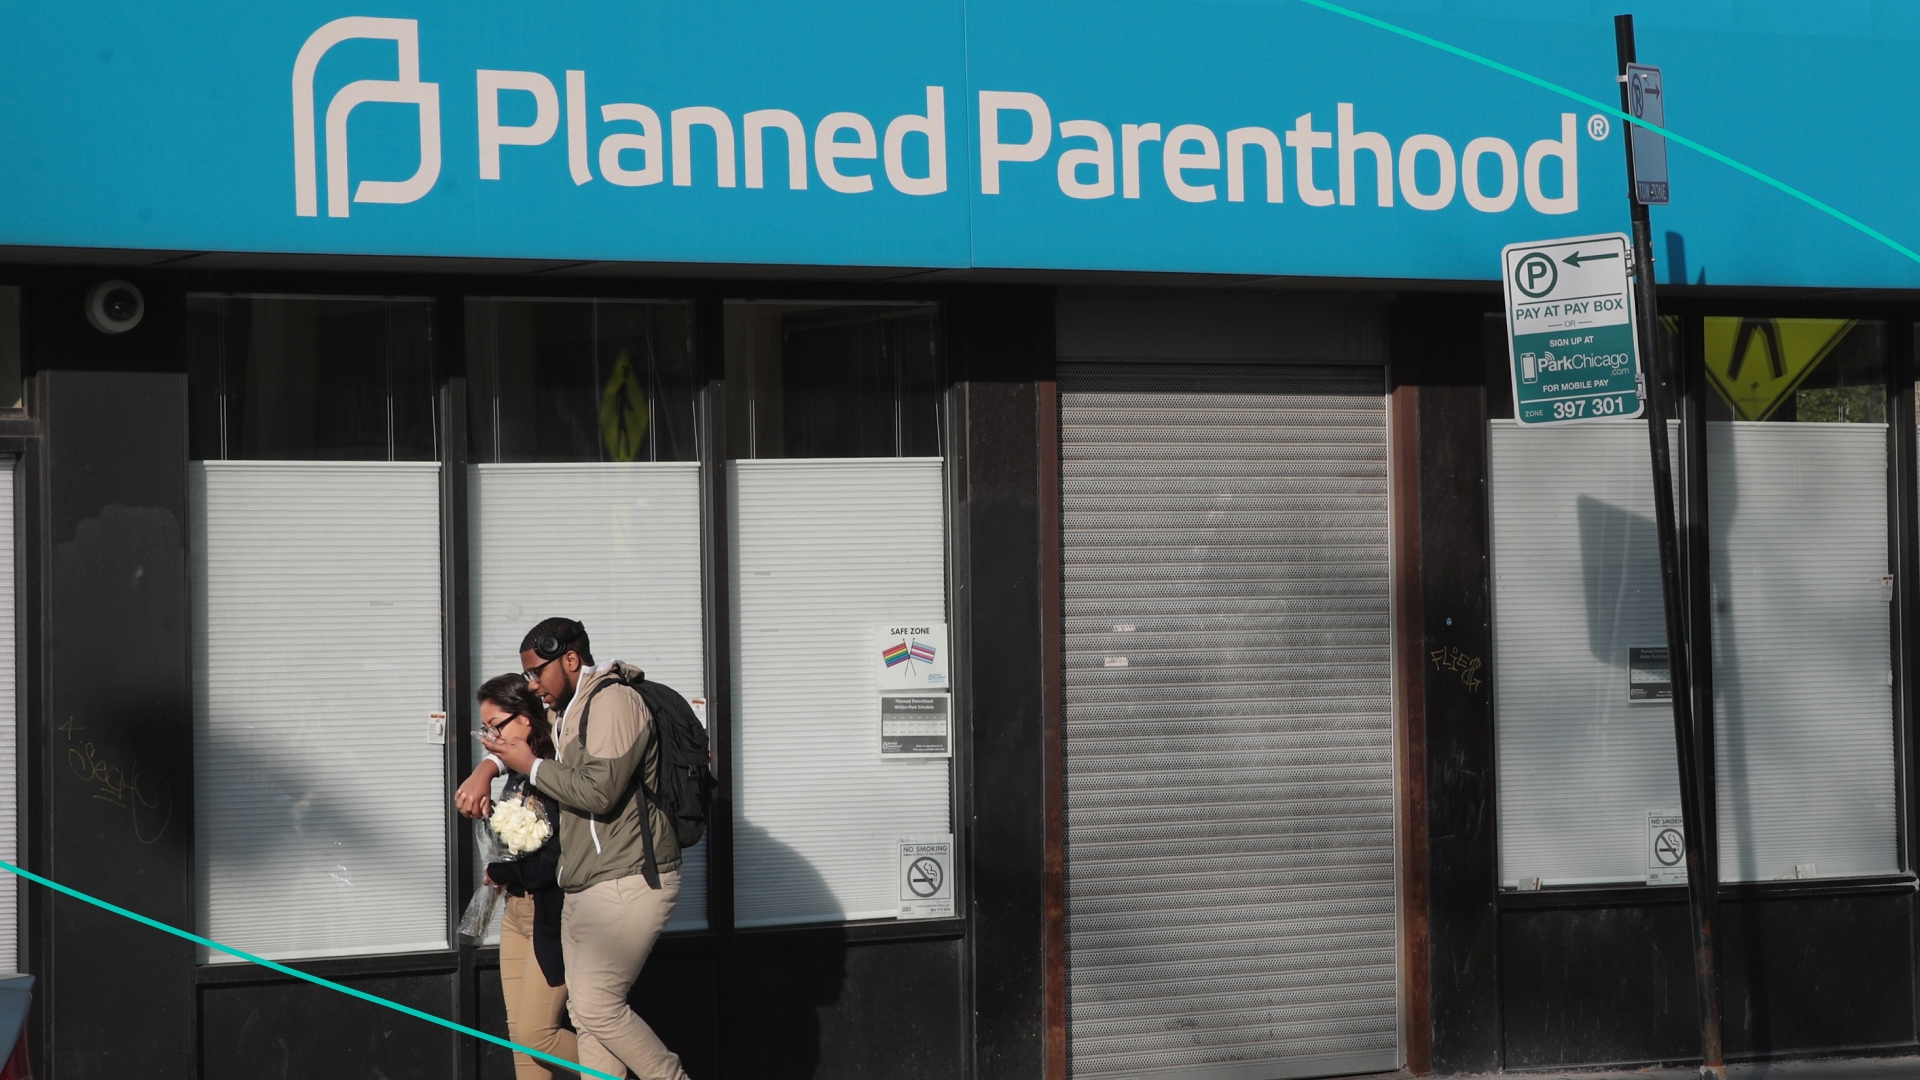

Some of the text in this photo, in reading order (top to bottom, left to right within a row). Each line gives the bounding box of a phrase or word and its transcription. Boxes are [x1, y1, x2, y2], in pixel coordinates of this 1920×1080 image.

[477, 70, 947, 195] Planned
[1527, 261, 1547, 290] P
[1516, 298, 1623, 321] PAY AT PAY BOX
[1564, 320, 1576, 328] OR
[1549, 338, 1569, 347] SIGN
[1571, 337, 1583, 345] UP
[1537, 352, 1629, 373] ParkChicago
[1610, 367, 1630, 376] .com
[1542, 379, 1609, 393] FOR MOBILE PAY
[1553, 399, 1586, 419] 397
[1592, 396, 1624, 415] 301
[910, 627, 930, 635] ZONE
